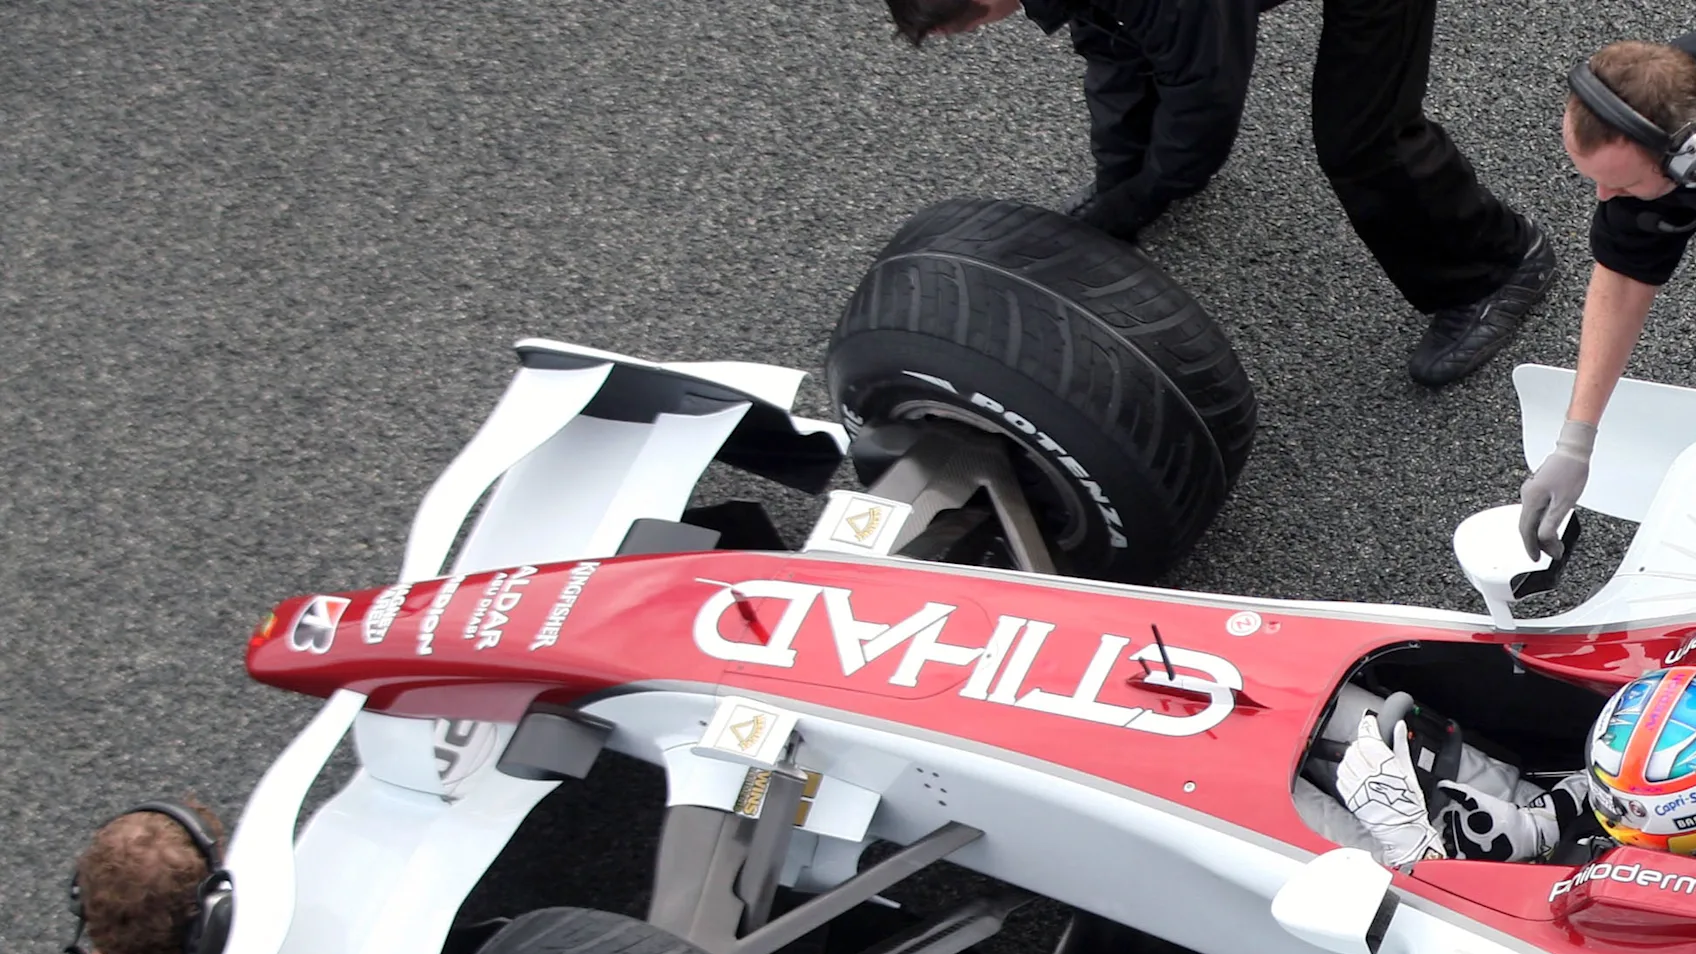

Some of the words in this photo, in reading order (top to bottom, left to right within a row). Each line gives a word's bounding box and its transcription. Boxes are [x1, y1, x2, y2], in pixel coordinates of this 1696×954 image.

[971, 391, 1129, 550] POTENZA
[463, 598, 495, 640] DHABI
[474, 563, 540, 651] ALDAR
[527, 561, 601, 652] KINGFISHER
[693, 578, 1244, 738] ETIHAD
